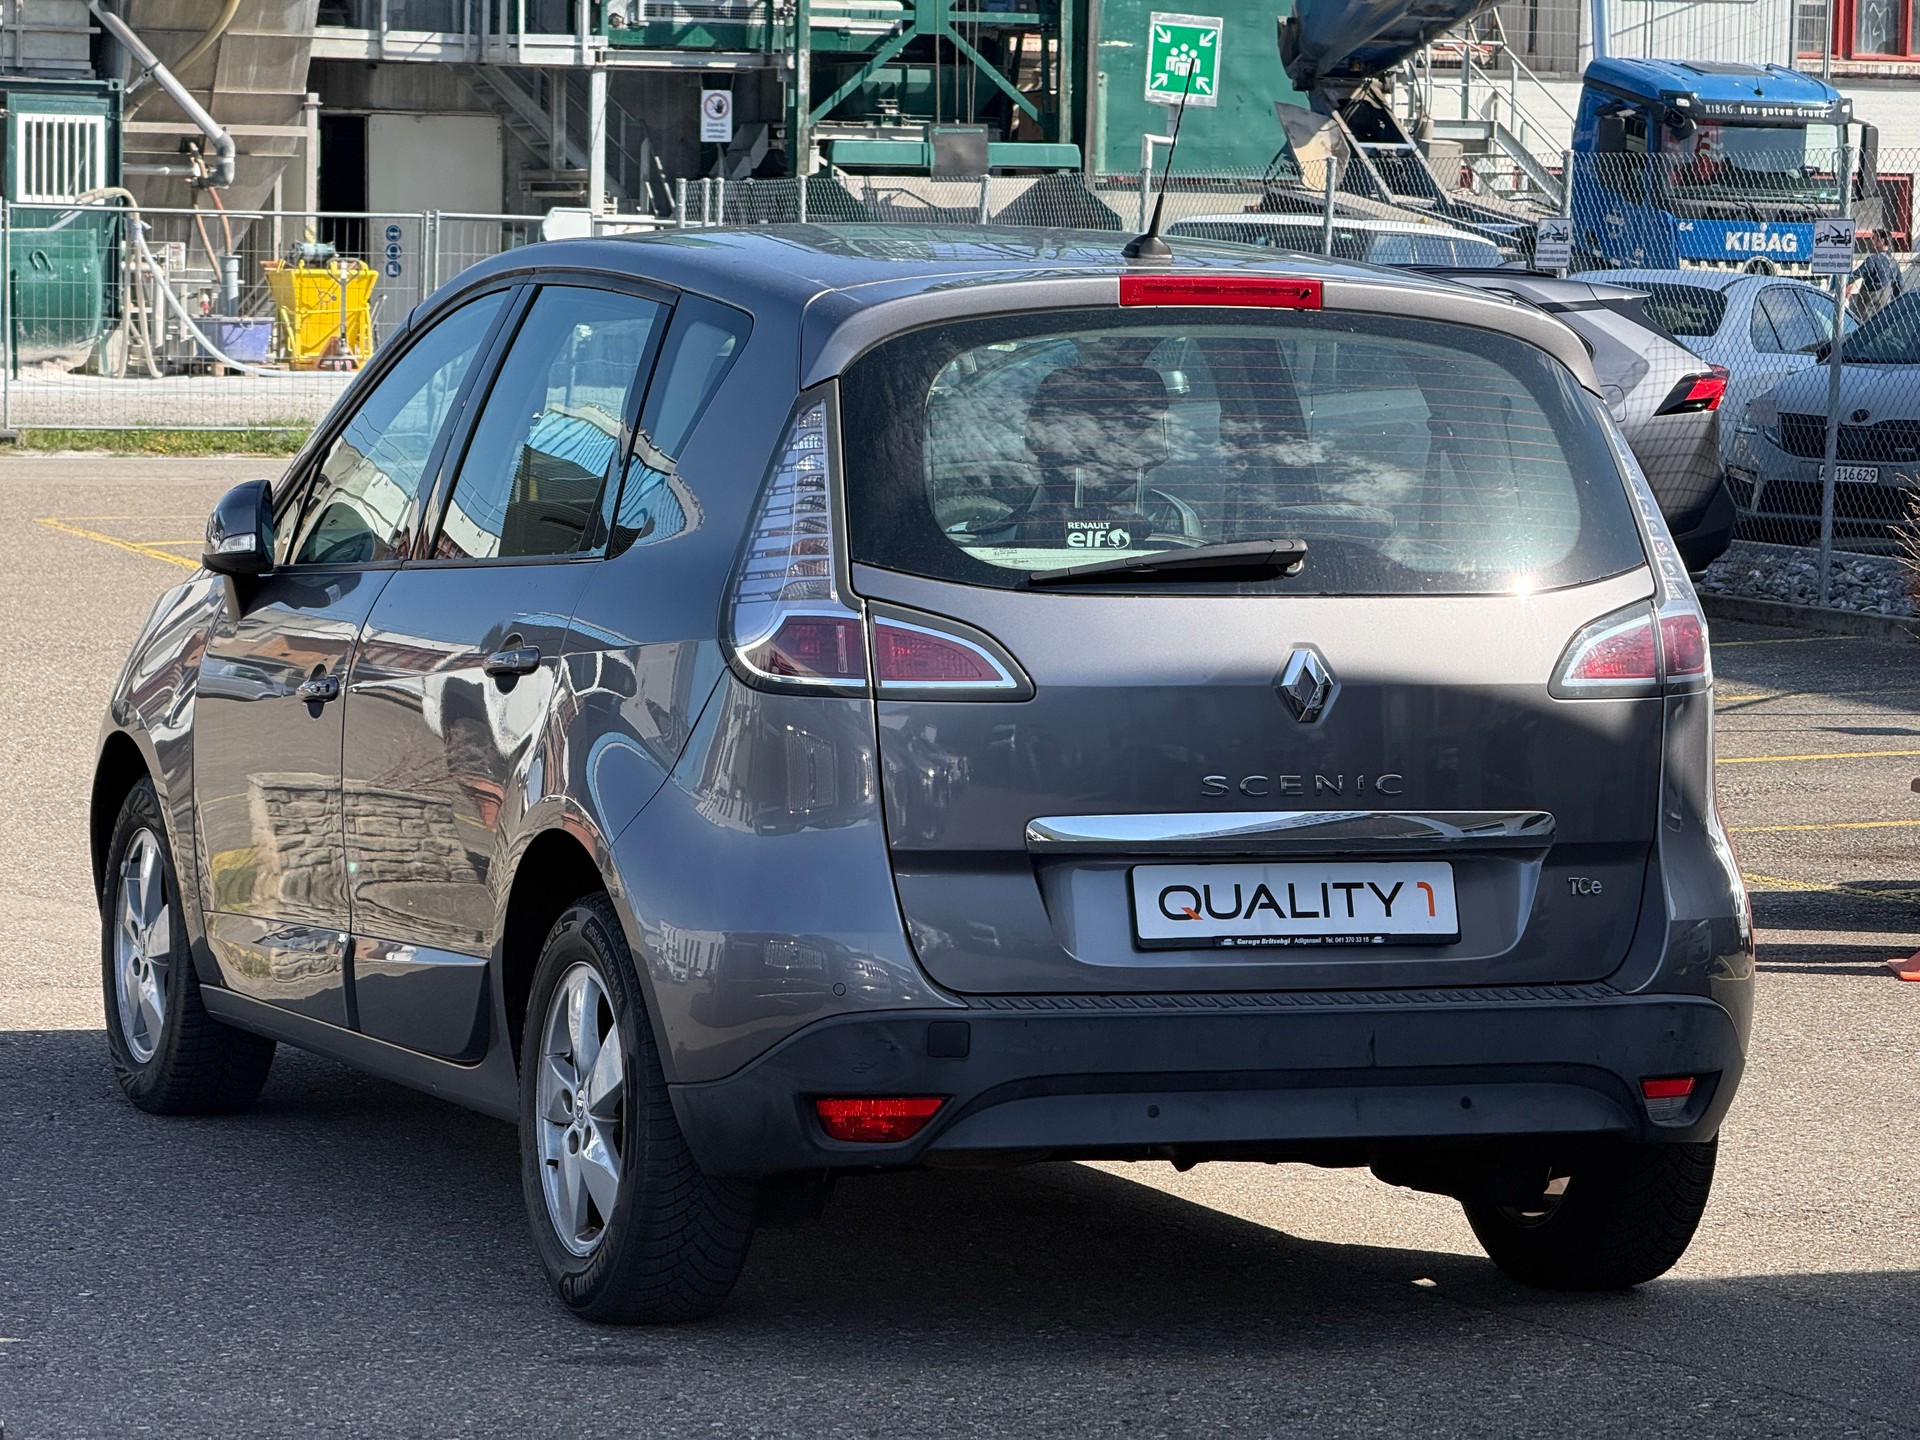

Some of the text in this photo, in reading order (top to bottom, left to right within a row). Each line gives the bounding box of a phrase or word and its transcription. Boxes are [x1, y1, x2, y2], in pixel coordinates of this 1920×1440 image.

[1705, 104, 1830, 119] KIBAG. Aus gutem Grund.
[1725, 231, 1797, 252] KIBAG
[1067, 521, 1110, 529] RENAULT
[1067, 530, 1106, 547] elf
[1201, 773, 1404, 796] SCENIC
[1568, 877, 1602, 895] TCe
[1158, 881, 1404, 921] QUALITY
[1237, 938, 1261, 946] Garage
